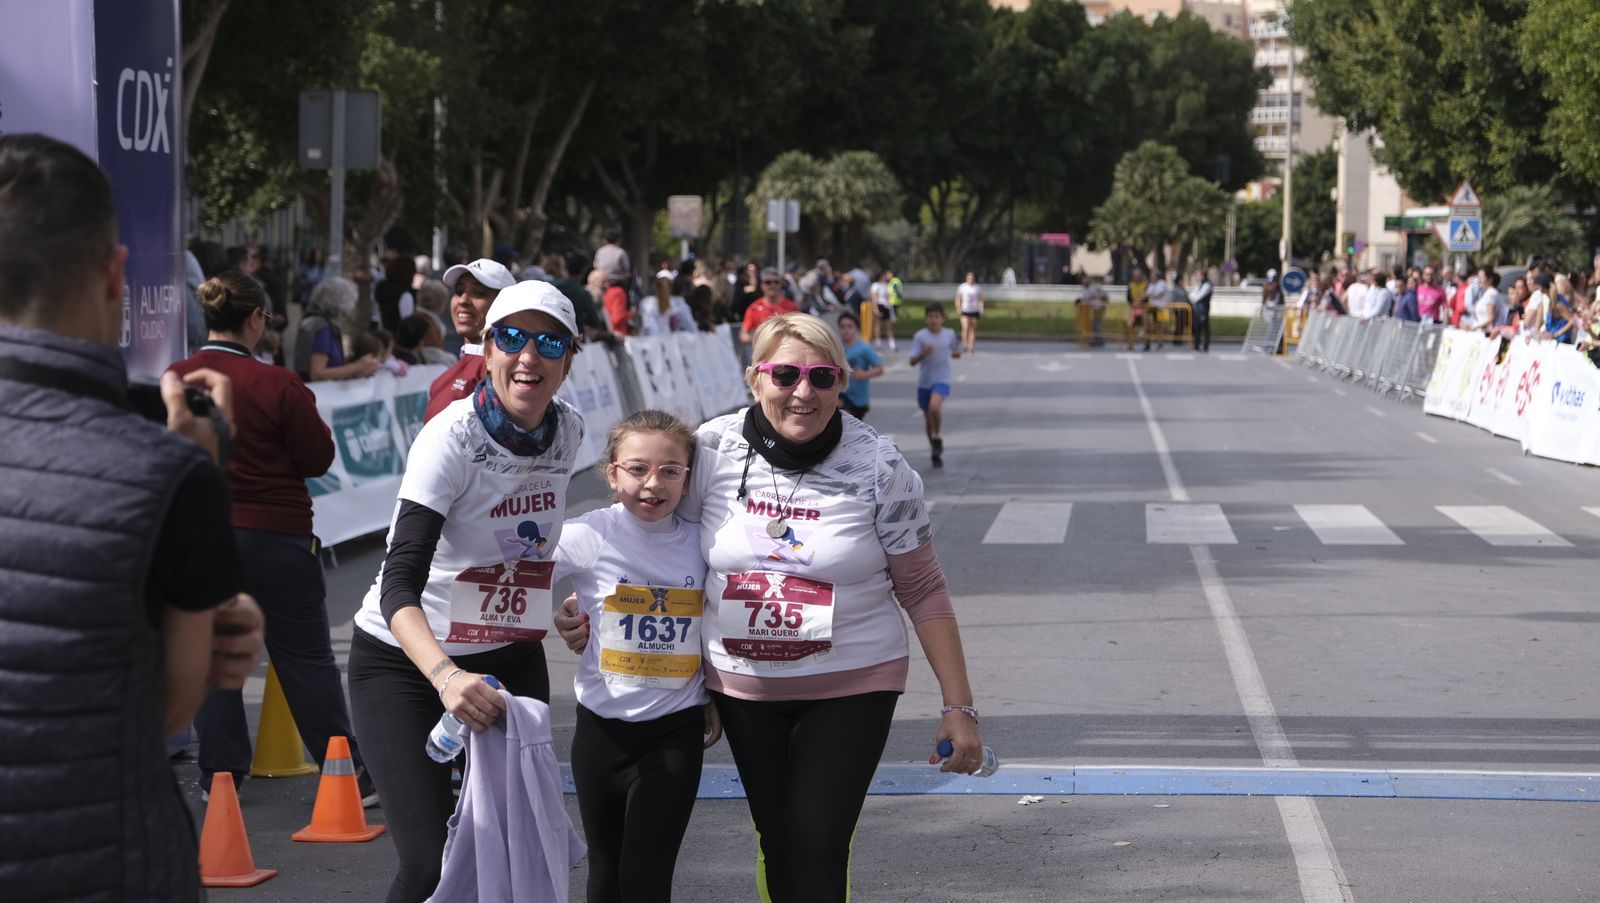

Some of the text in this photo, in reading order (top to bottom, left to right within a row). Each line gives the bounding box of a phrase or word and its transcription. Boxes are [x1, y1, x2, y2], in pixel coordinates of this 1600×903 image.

[1561, 383, 1585, 407] vithas
[529, 481, 539, 492] DE
[540, 480, 552, 489] LA
[490, 491, 556, 518] MUJER
[746, 497, 821, 521] MUJER
[736, 583, 761, 591] MUJER
[478, 585, 528, 616] 736
[480, 613, 498, 622] ALMA
[500, 614, 506, 622] Y
[507, 615, 522, 624] EVA
[744, 602, 804, 629] 735
[618, 614, 692, 643] 1637
[749, 628, 799, 637] MARI QUERO
[638, 642, 675, 650] ALMUCHI
